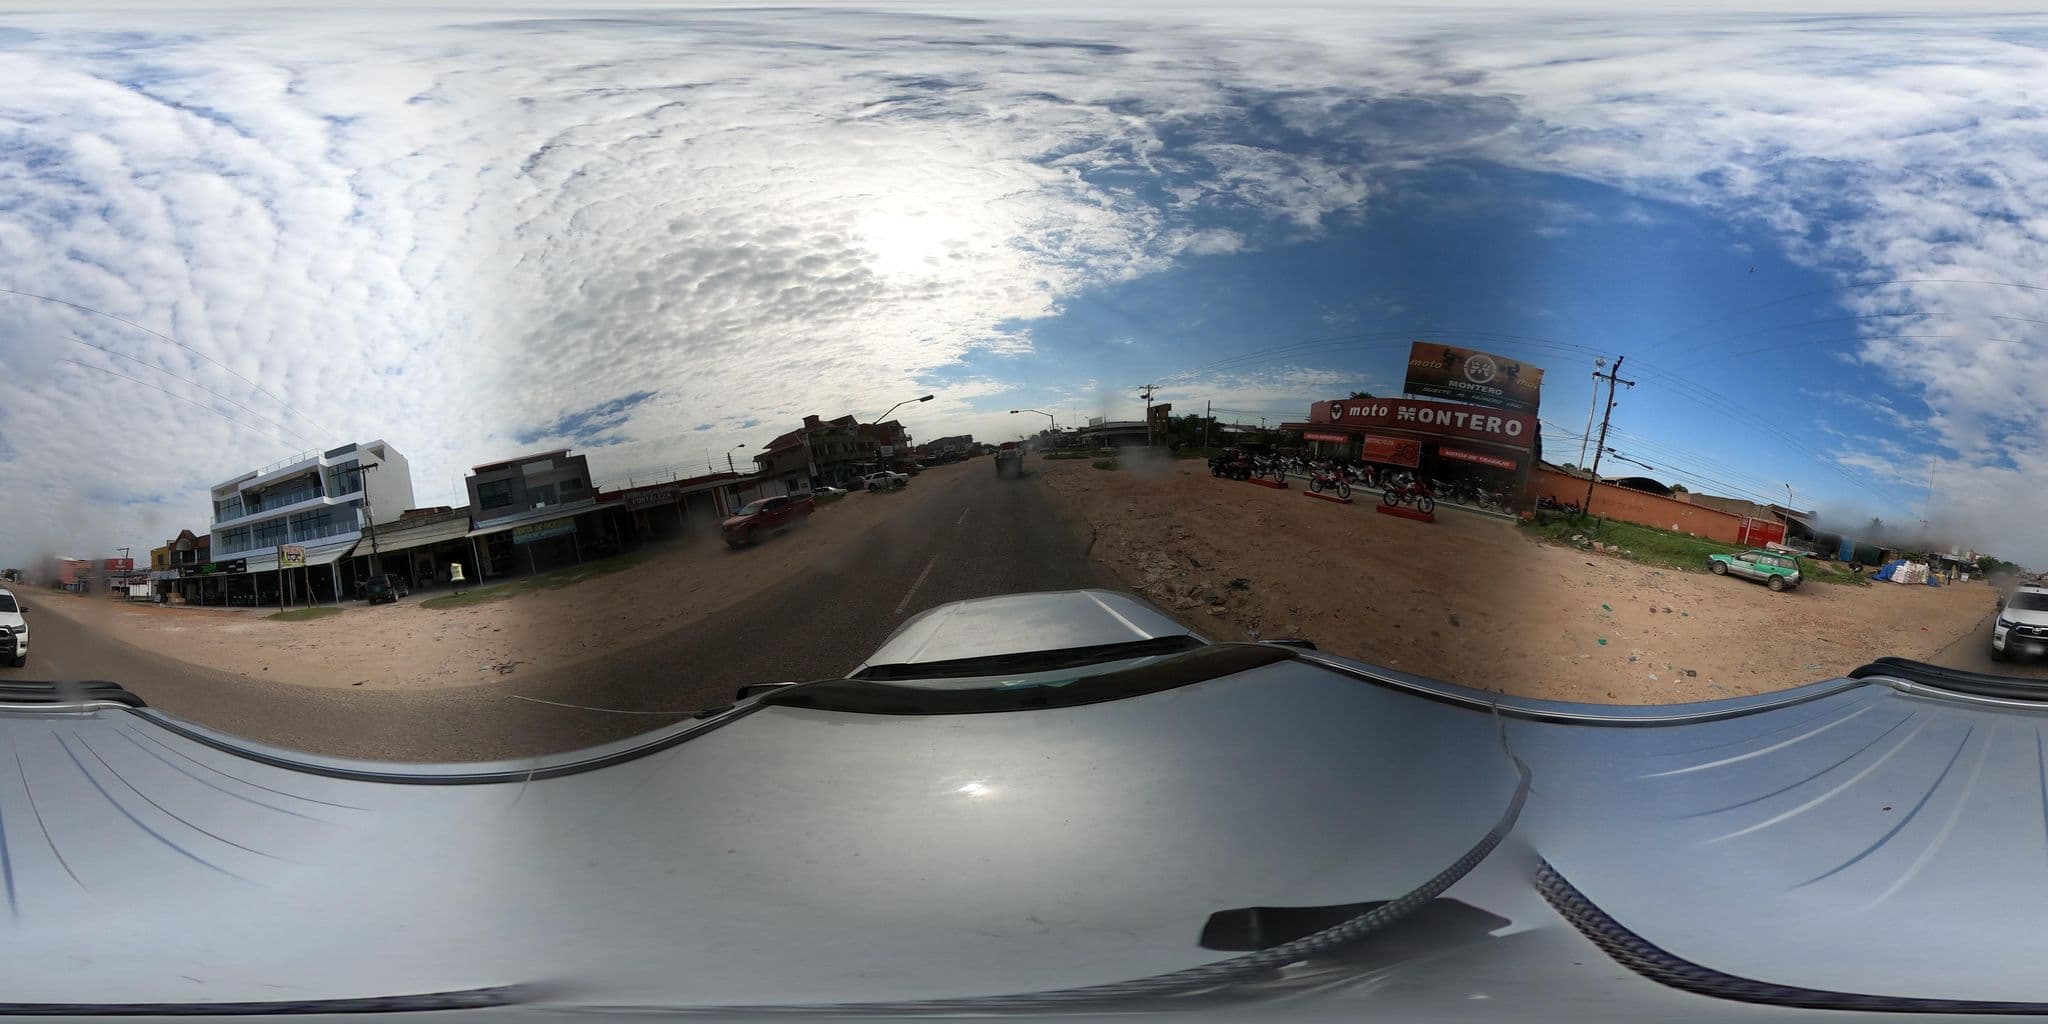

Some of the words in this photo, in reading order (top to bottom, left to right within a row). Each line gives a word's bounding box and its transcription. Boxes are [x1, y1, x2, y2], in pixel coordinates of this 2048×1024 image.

[1410, 359, 1442, 370] moto
[1448, 380, 1503, 396] MONTERO
[1349, 404, 1389, 417] moto
[1397, 406, 1522, 437] MONTERO
